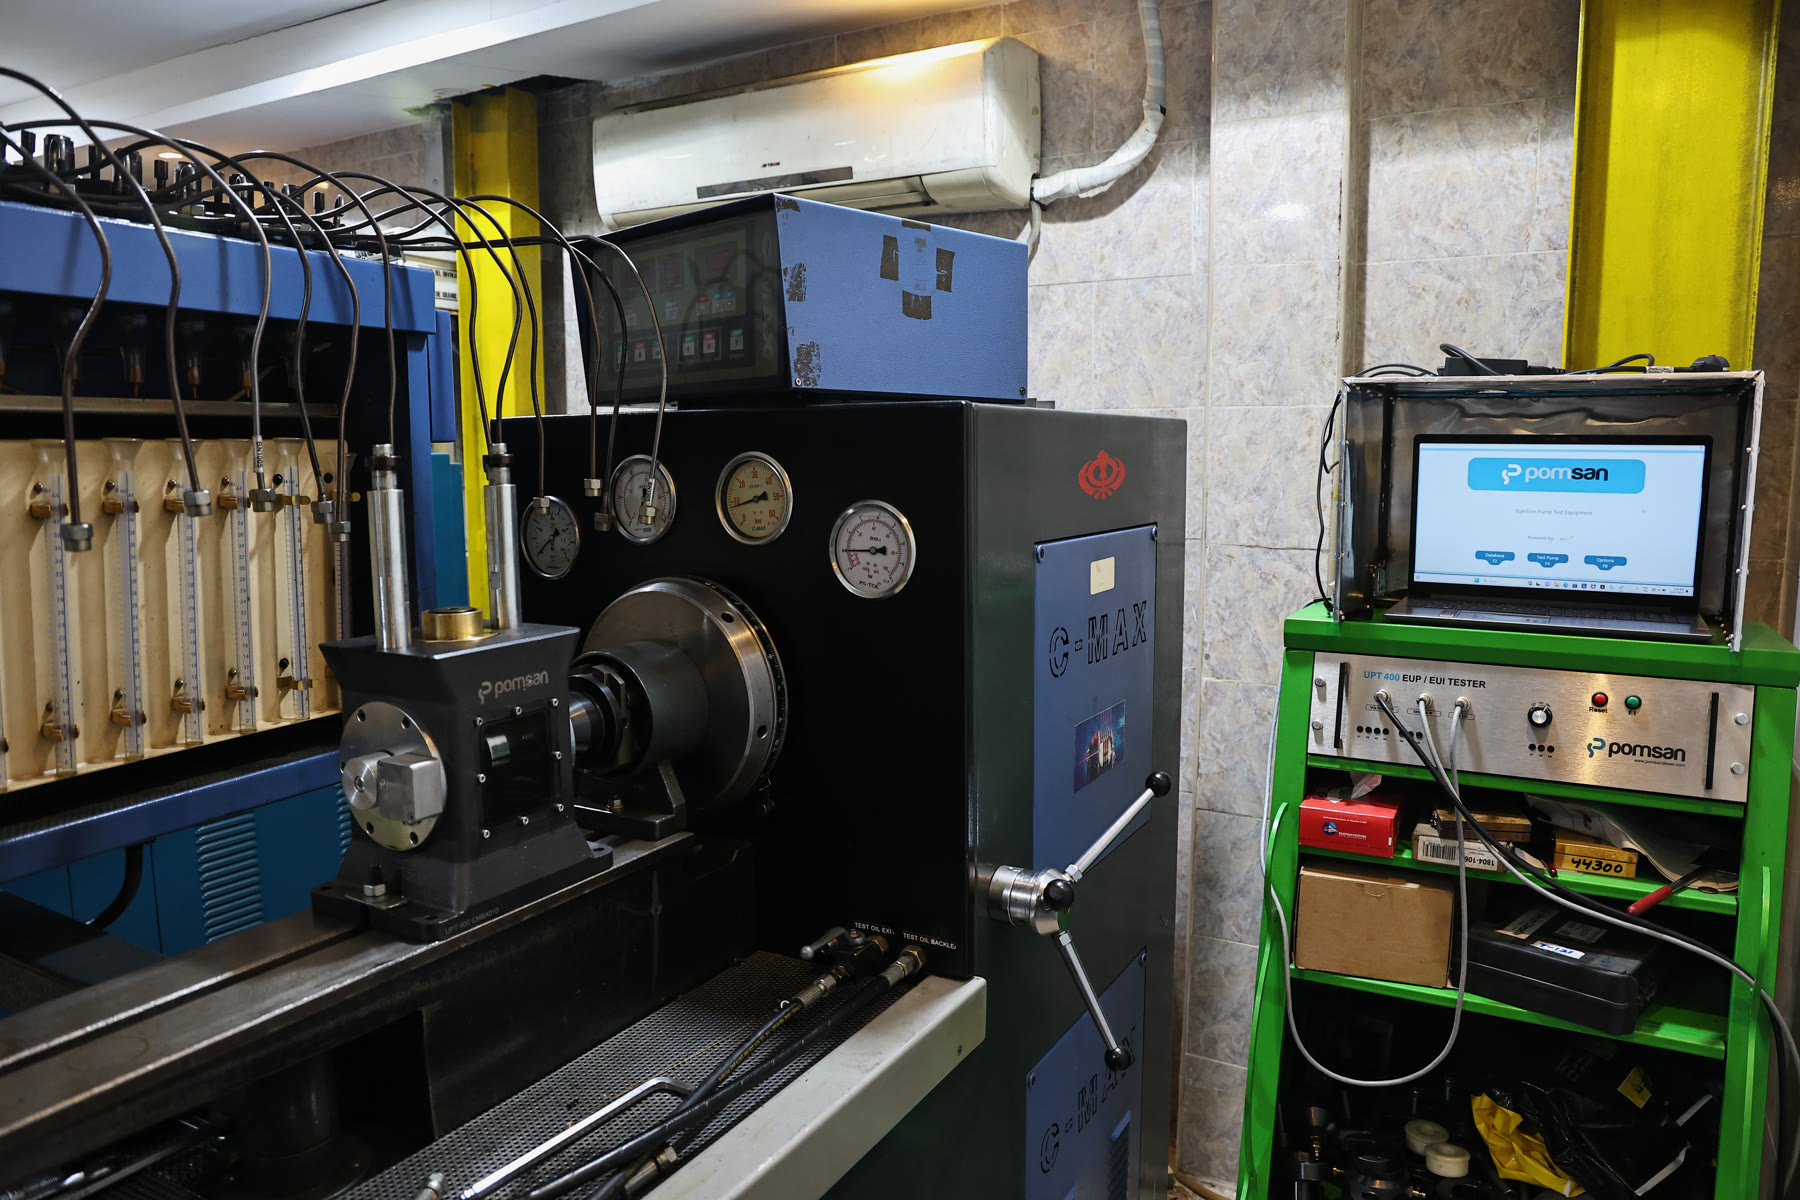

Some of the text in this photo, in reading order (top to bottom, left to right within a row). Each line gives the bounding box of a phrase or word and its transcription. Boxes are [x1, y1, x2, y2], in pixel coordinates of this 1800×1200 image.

[752, 471, 758, 479] 30
[1525, 467, 1608, 483] pomsan
[739, 480, 745, 488] 20
[772, 493, 779, 501] 50
[769, 509, 776, 518] 60
[1049, 600, 1147, 678] C-MAX
[494, 671, 549, 699] pomsan
[1364, 671, 1383, 680] UPT
[1384, 672, 1400, 681] 400
[1402, 674, 1422, 683] EUP
[1429, 676, 1445, 685] EUI
[1448, 678, 1486, 688] TESTER
[1608, 742, 1686, 762] pomsan
[1571, 857, 1623, 874] 44300
[854, 922, 869, 930] TEST
[870, 925, 880, 933] OIL
[903, 932, 918, 941] TEST
[920, 936, 930, 944] OIL
